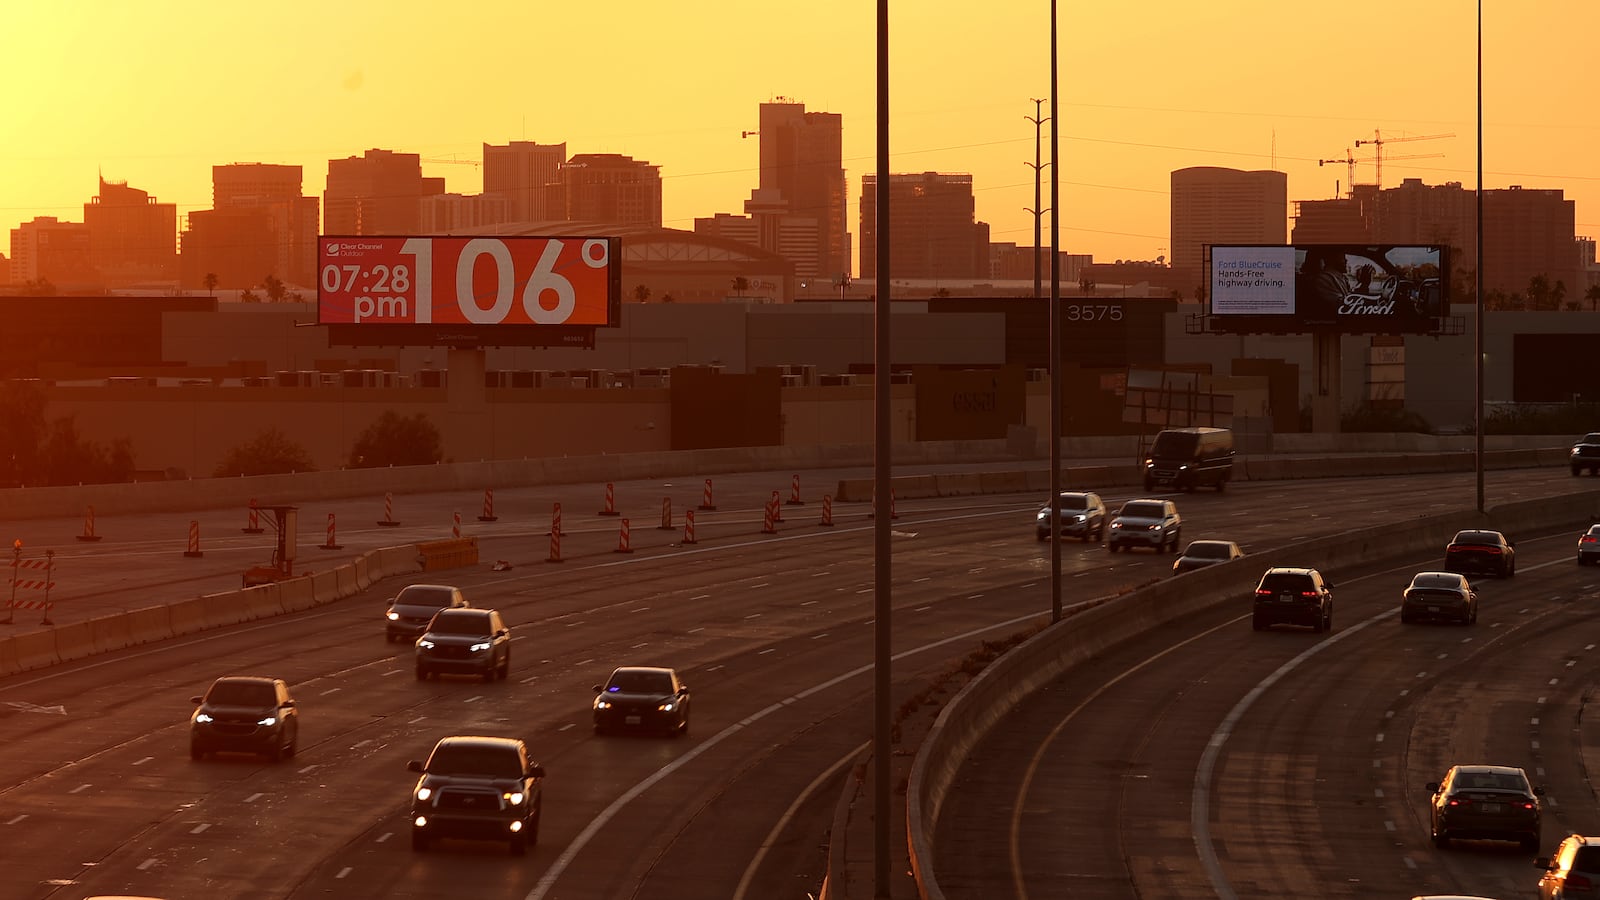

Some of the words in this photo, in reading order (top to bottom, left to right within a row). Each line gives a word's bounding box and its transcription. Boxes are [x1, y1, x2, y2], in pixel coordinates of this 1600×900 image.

[322, 264, 409, 293] 07:28
[1219, 279, 1252, 288] highway
[1255, 279, 1286, 288] driving.
[354, 296, 407, 323] pm
[1067, 305, 1123, 321] 3575
